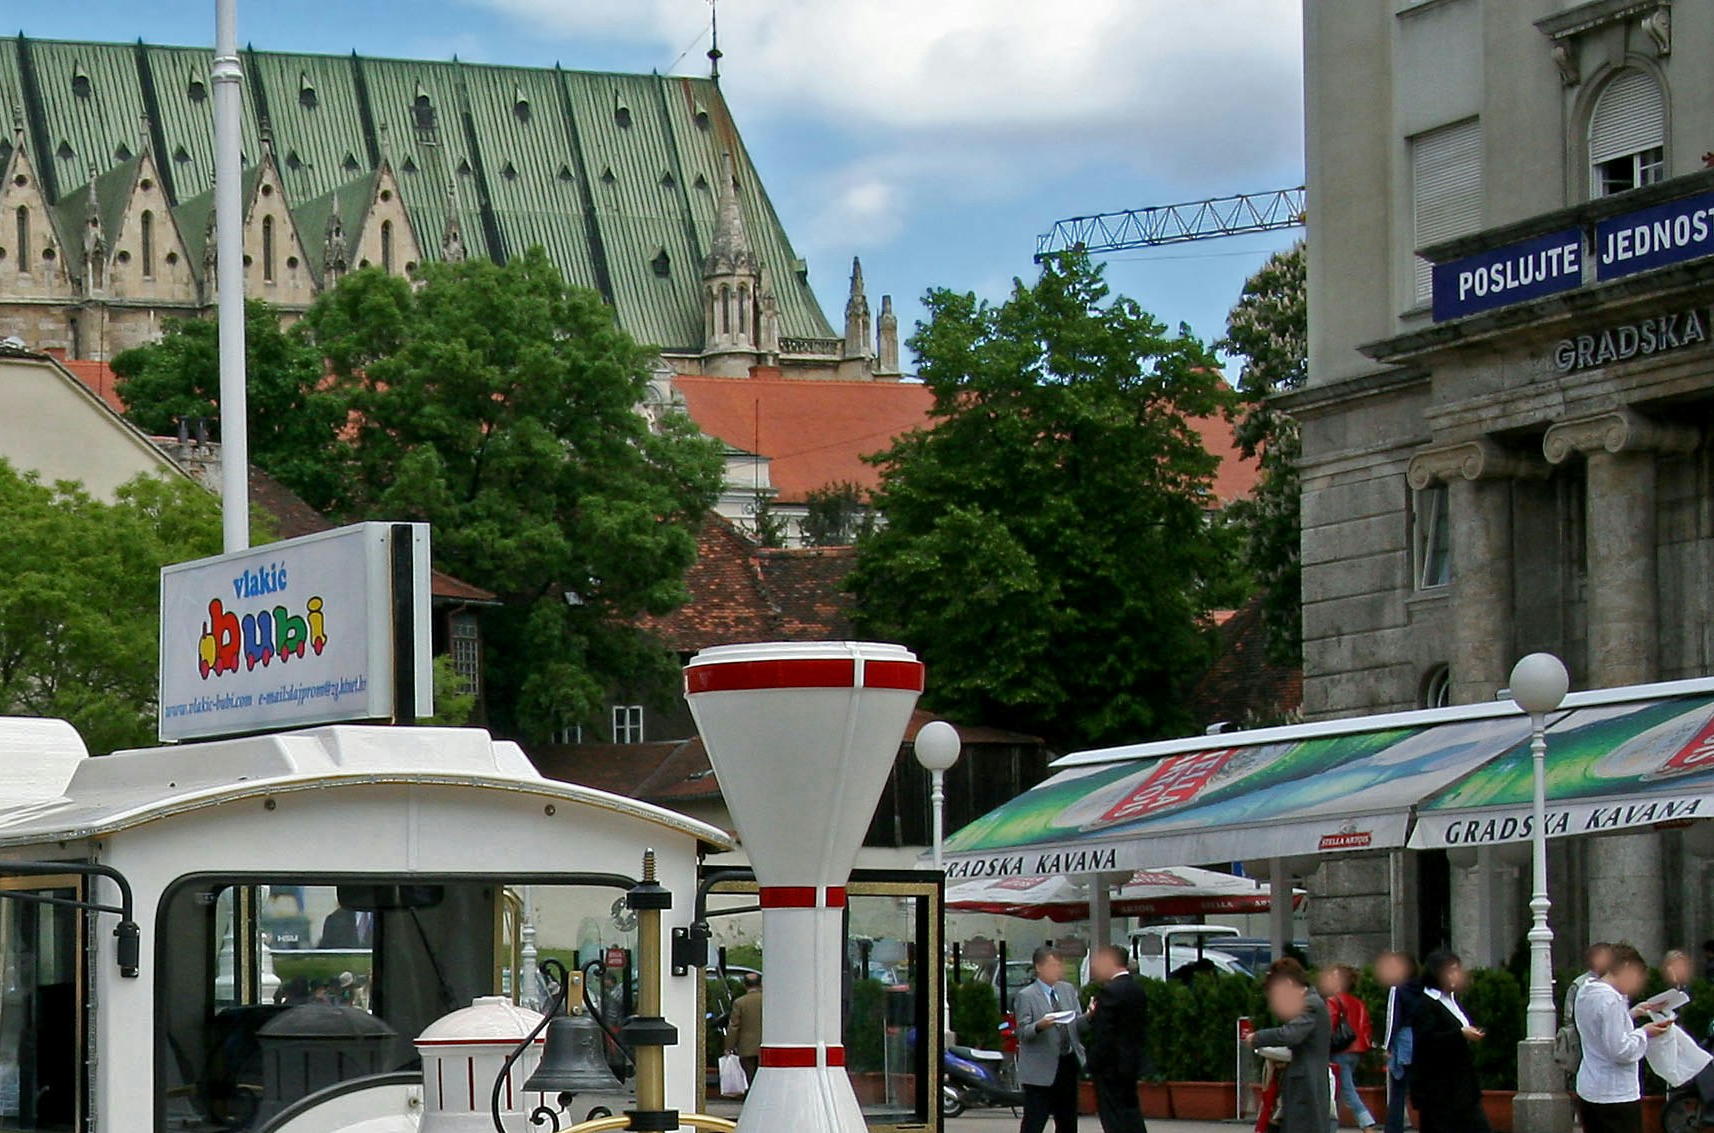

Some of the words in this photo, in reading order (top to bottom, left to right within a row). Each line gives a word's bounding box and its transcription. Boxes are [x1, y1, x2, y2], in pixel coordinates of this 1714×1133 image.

[1459, 243, 1579, 301] POSLUJTE
[1553, 310, 1705, 372] GRADSKA
[234, 561, 287, 599] vlakić
[199, 596, 327, 680] bubi
[1584, 799, 1702, 829] KAVANA
[942, 857, 1024, 877] RADSKA
[1036, 849, 1117, 873] KAVANA
